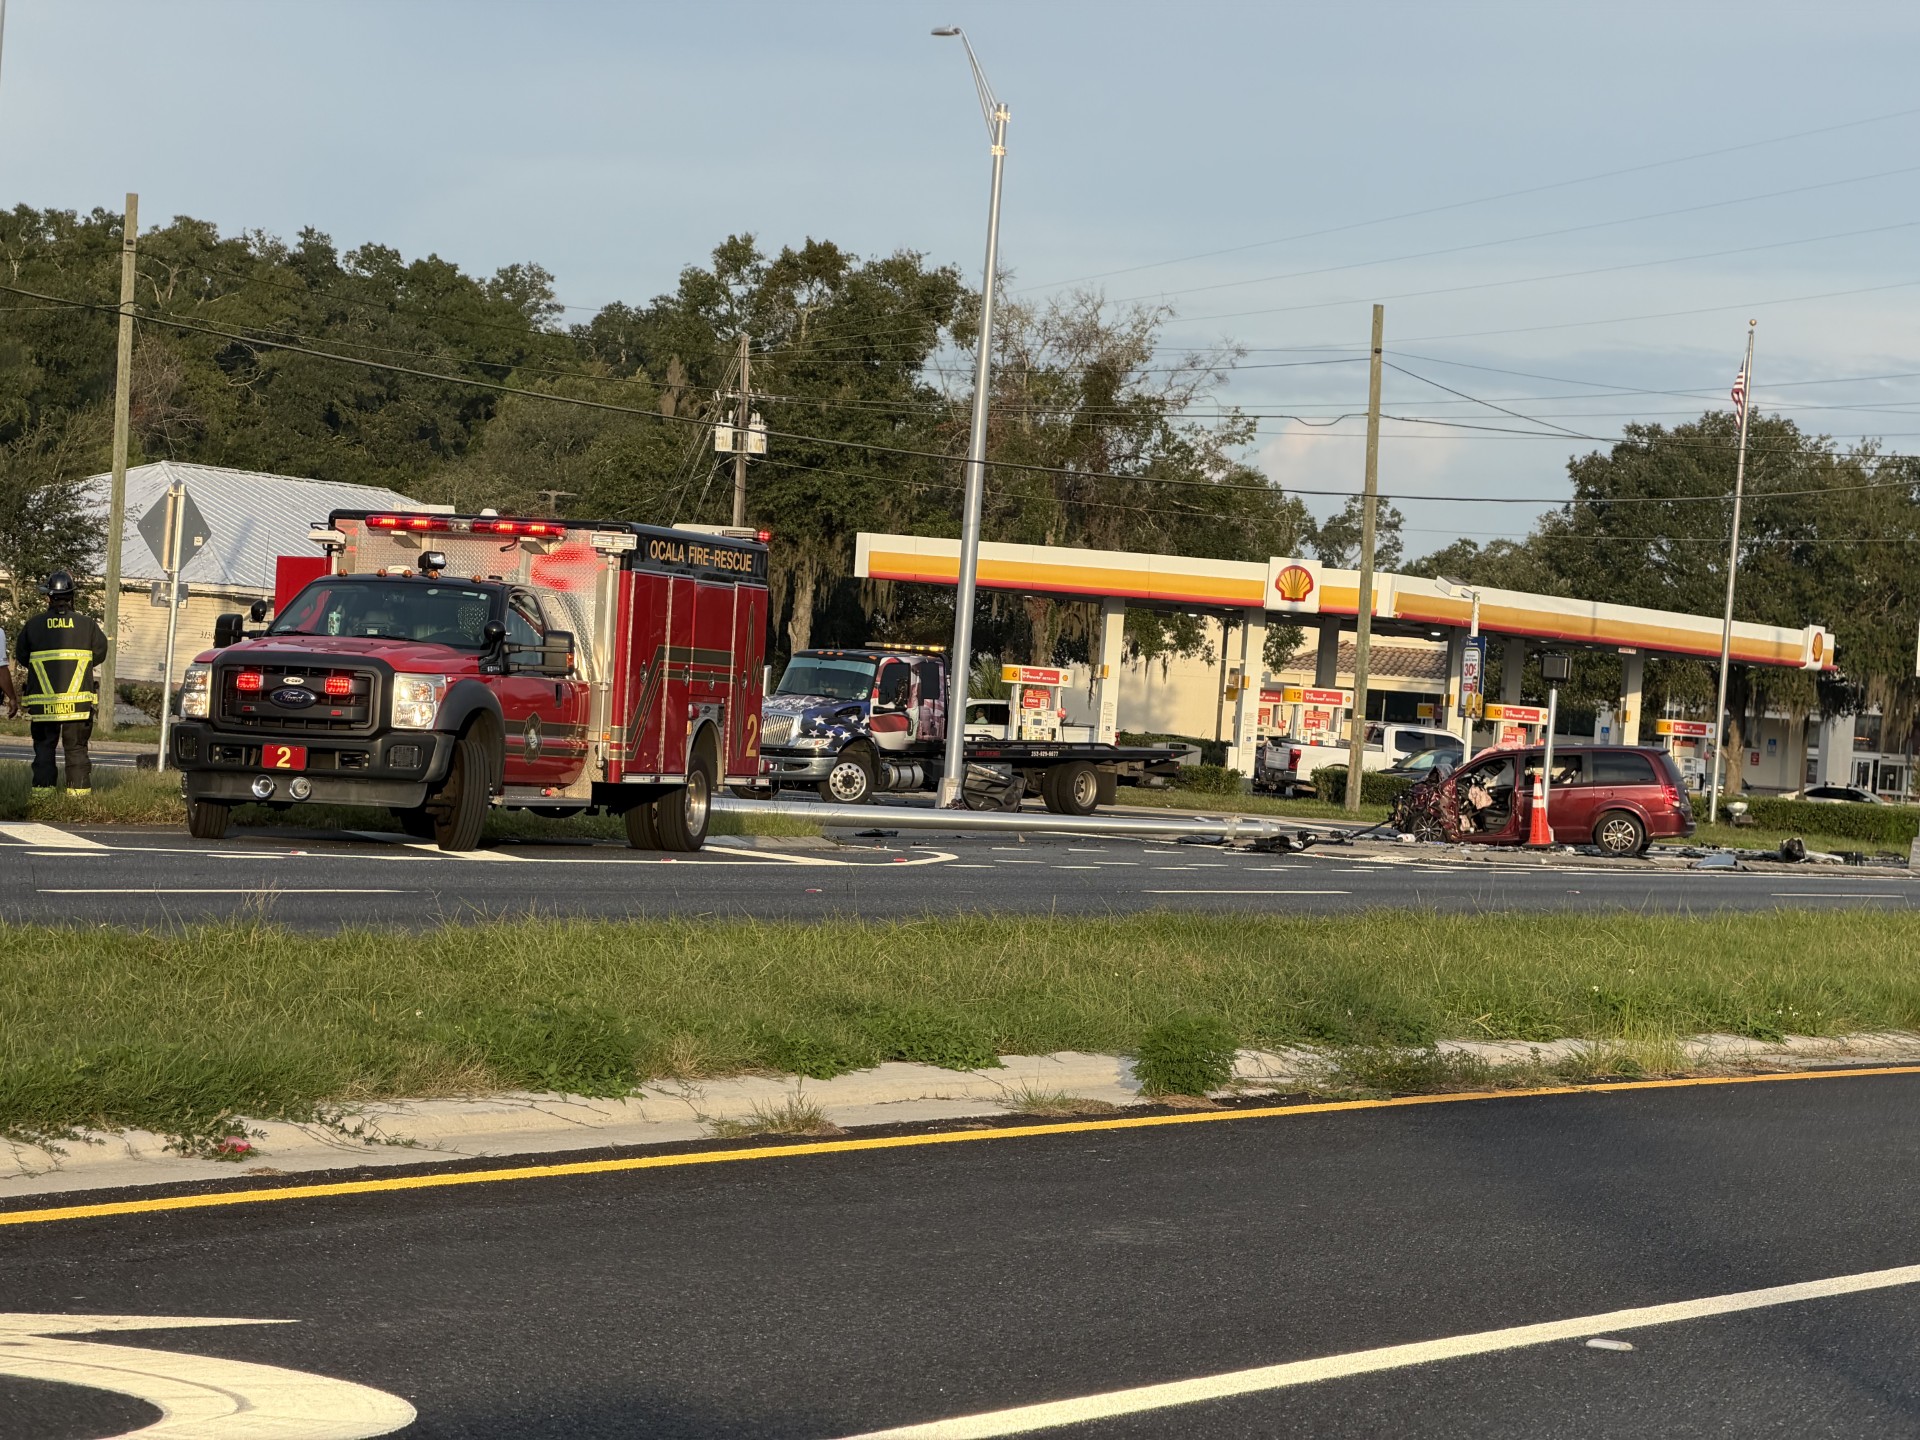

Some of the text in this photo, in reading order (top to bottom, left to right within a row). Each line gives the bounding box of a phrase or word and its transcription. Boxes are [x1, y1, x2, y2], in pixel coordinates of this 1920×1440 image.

[650, 540, 753, 572] OCALA FIRE-RESCUE
[47, 617, 75, 629] OCALA
[282, 690, 305, 702] Ford
[43, 702, 76, 715] HOWARD
[746, 713, 758, 757] 2
[276, 746, 291, 768] 2
